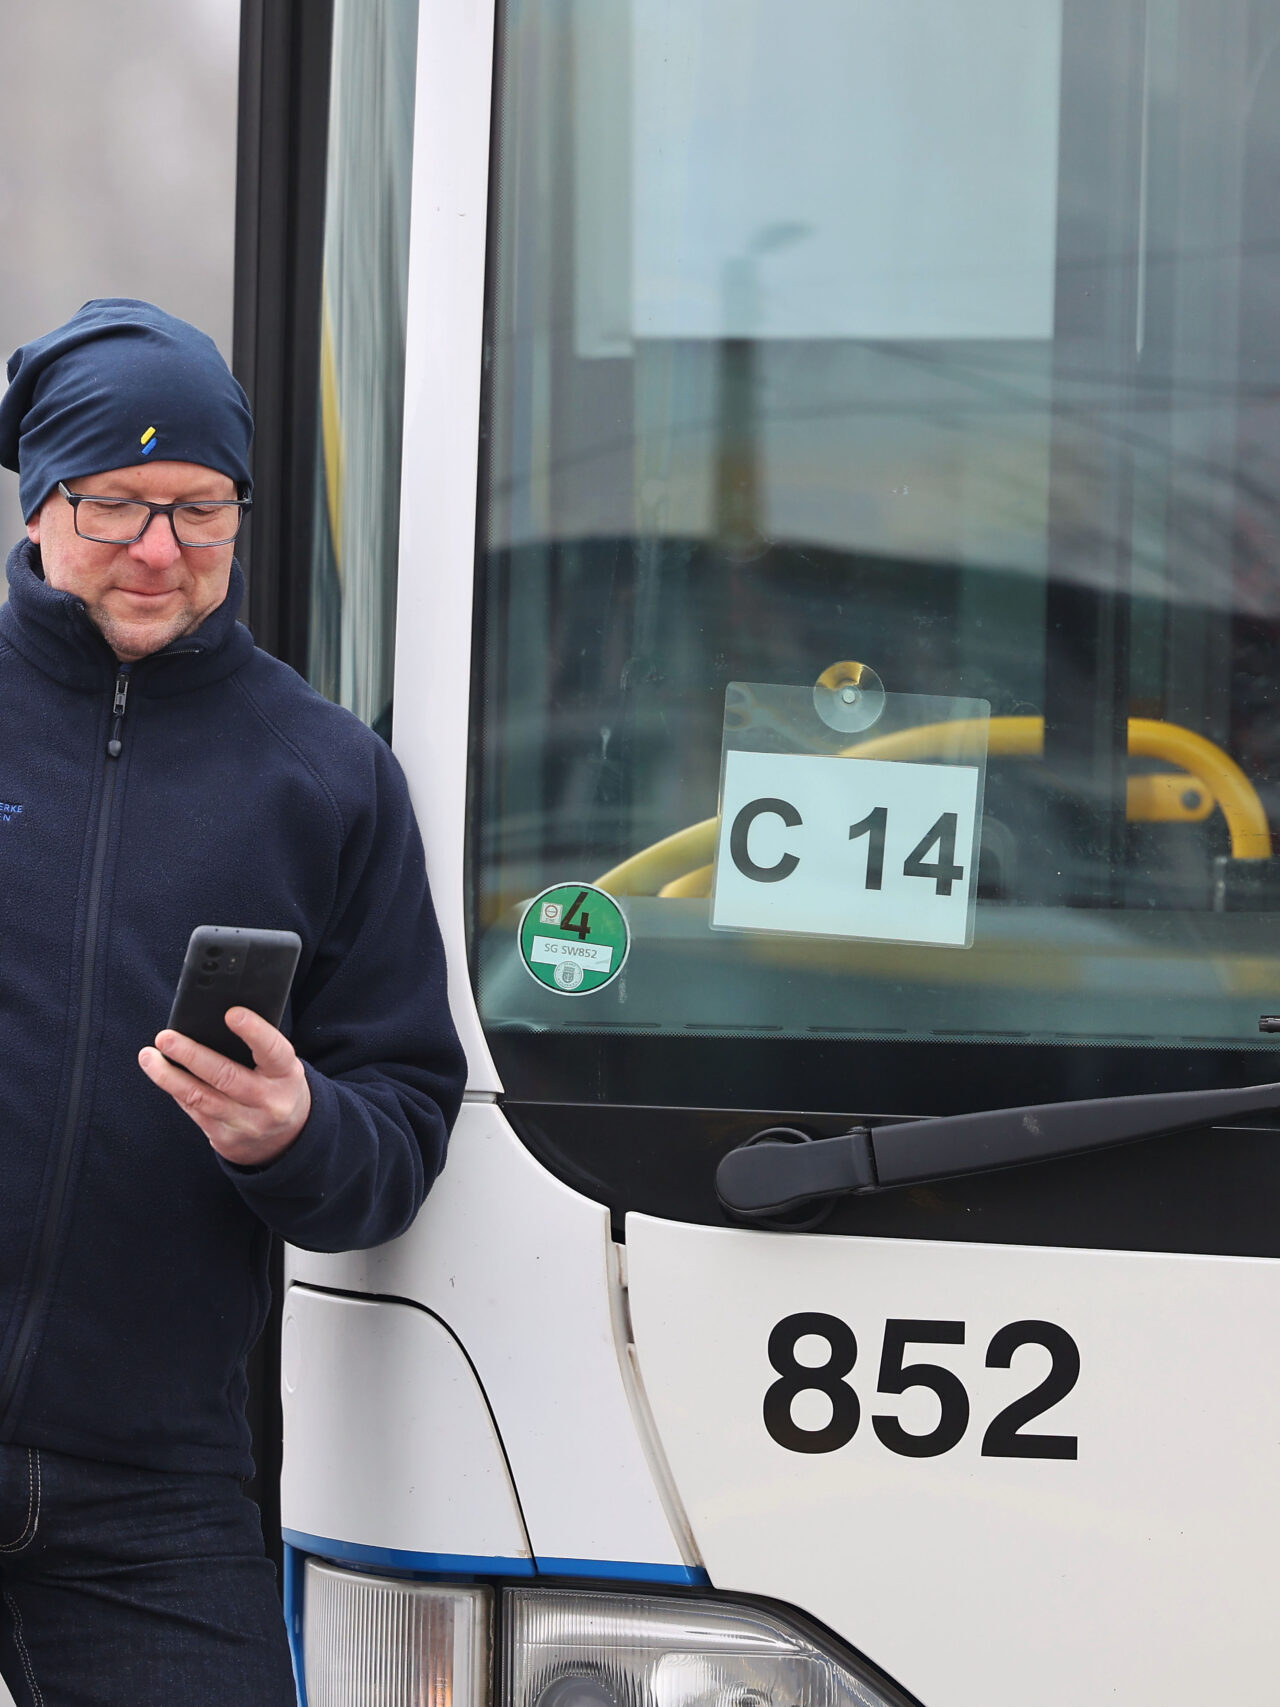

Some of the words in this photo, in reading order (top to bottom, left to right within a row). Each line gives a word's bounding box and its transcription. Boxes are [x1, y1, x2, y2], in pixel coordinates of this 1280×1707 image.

[730, 798, 803, 883] C
[848, 806, 964, 896] 14
[544, 943, 558, 953] SG
[561, 945, 598, 959] SW852
[560, 891, 591, 940] 4
[763, 1312, 1080, 1460] 852
